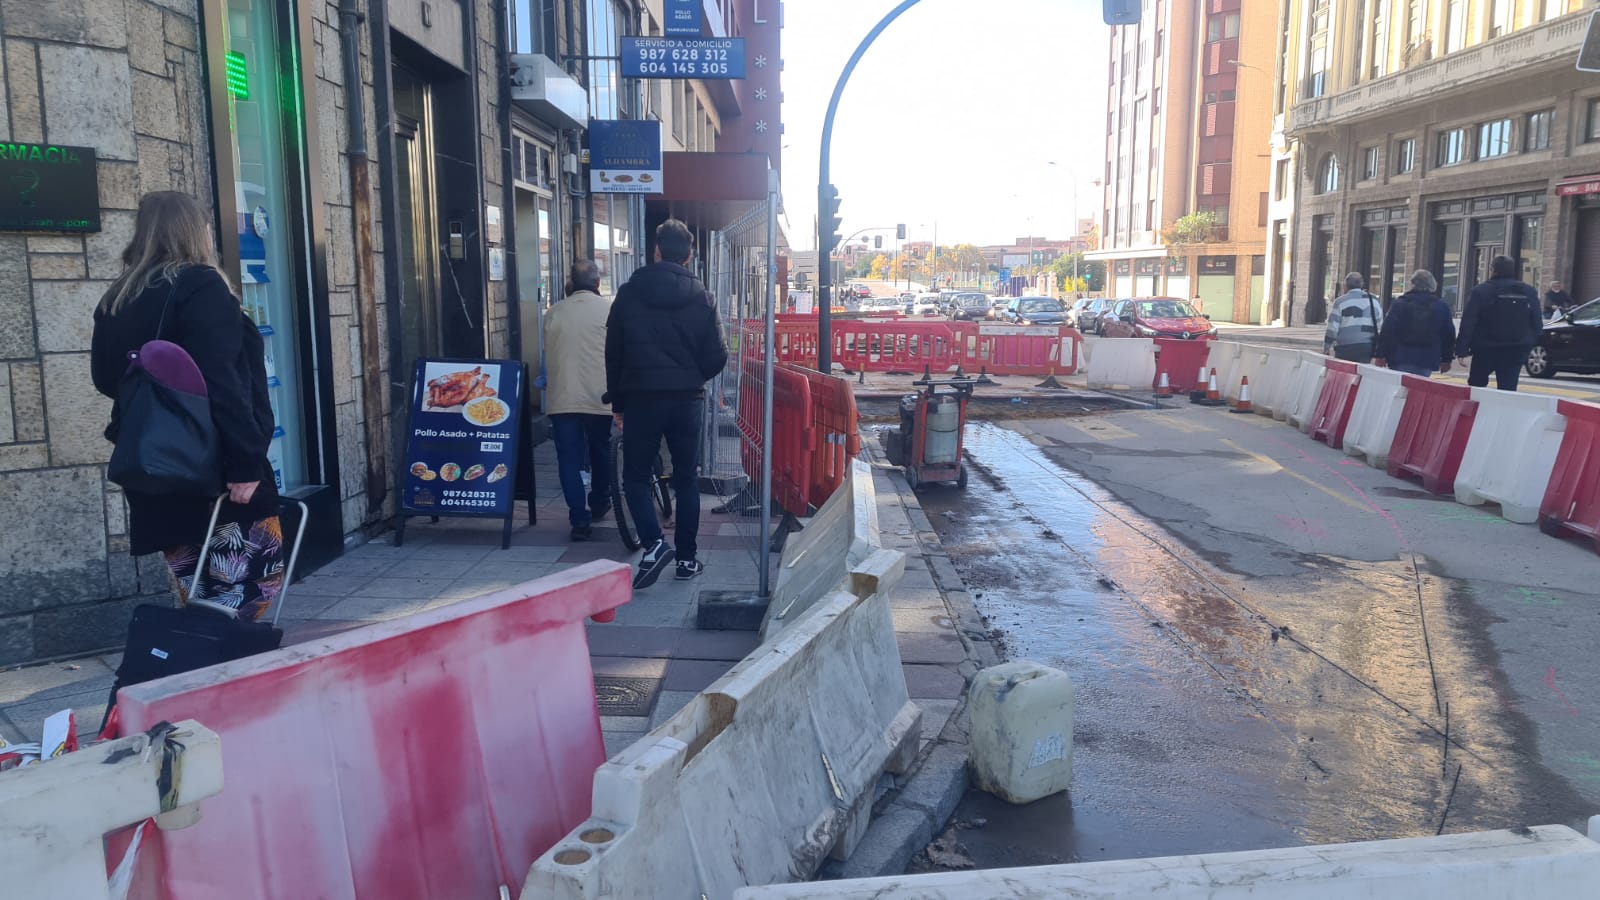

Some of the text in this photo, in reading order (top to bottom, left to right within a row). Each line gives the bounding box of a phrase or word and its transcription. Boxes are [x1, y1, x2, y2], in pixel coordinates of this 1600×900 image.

[635, 39, 732, 48] SERVICIO A DOMICILIO
[639, 49, 728, 61] 987 628 312
[639, 62, 728, 74] 604 145 305
[415, 428, 438, 437] Pollo
[439, 430, 467, 438] Asado
[476, 431, 511, 439] Patatas
[442, 490, 496, 499] 987628312
[440, 499, 496, 507] 604145305
